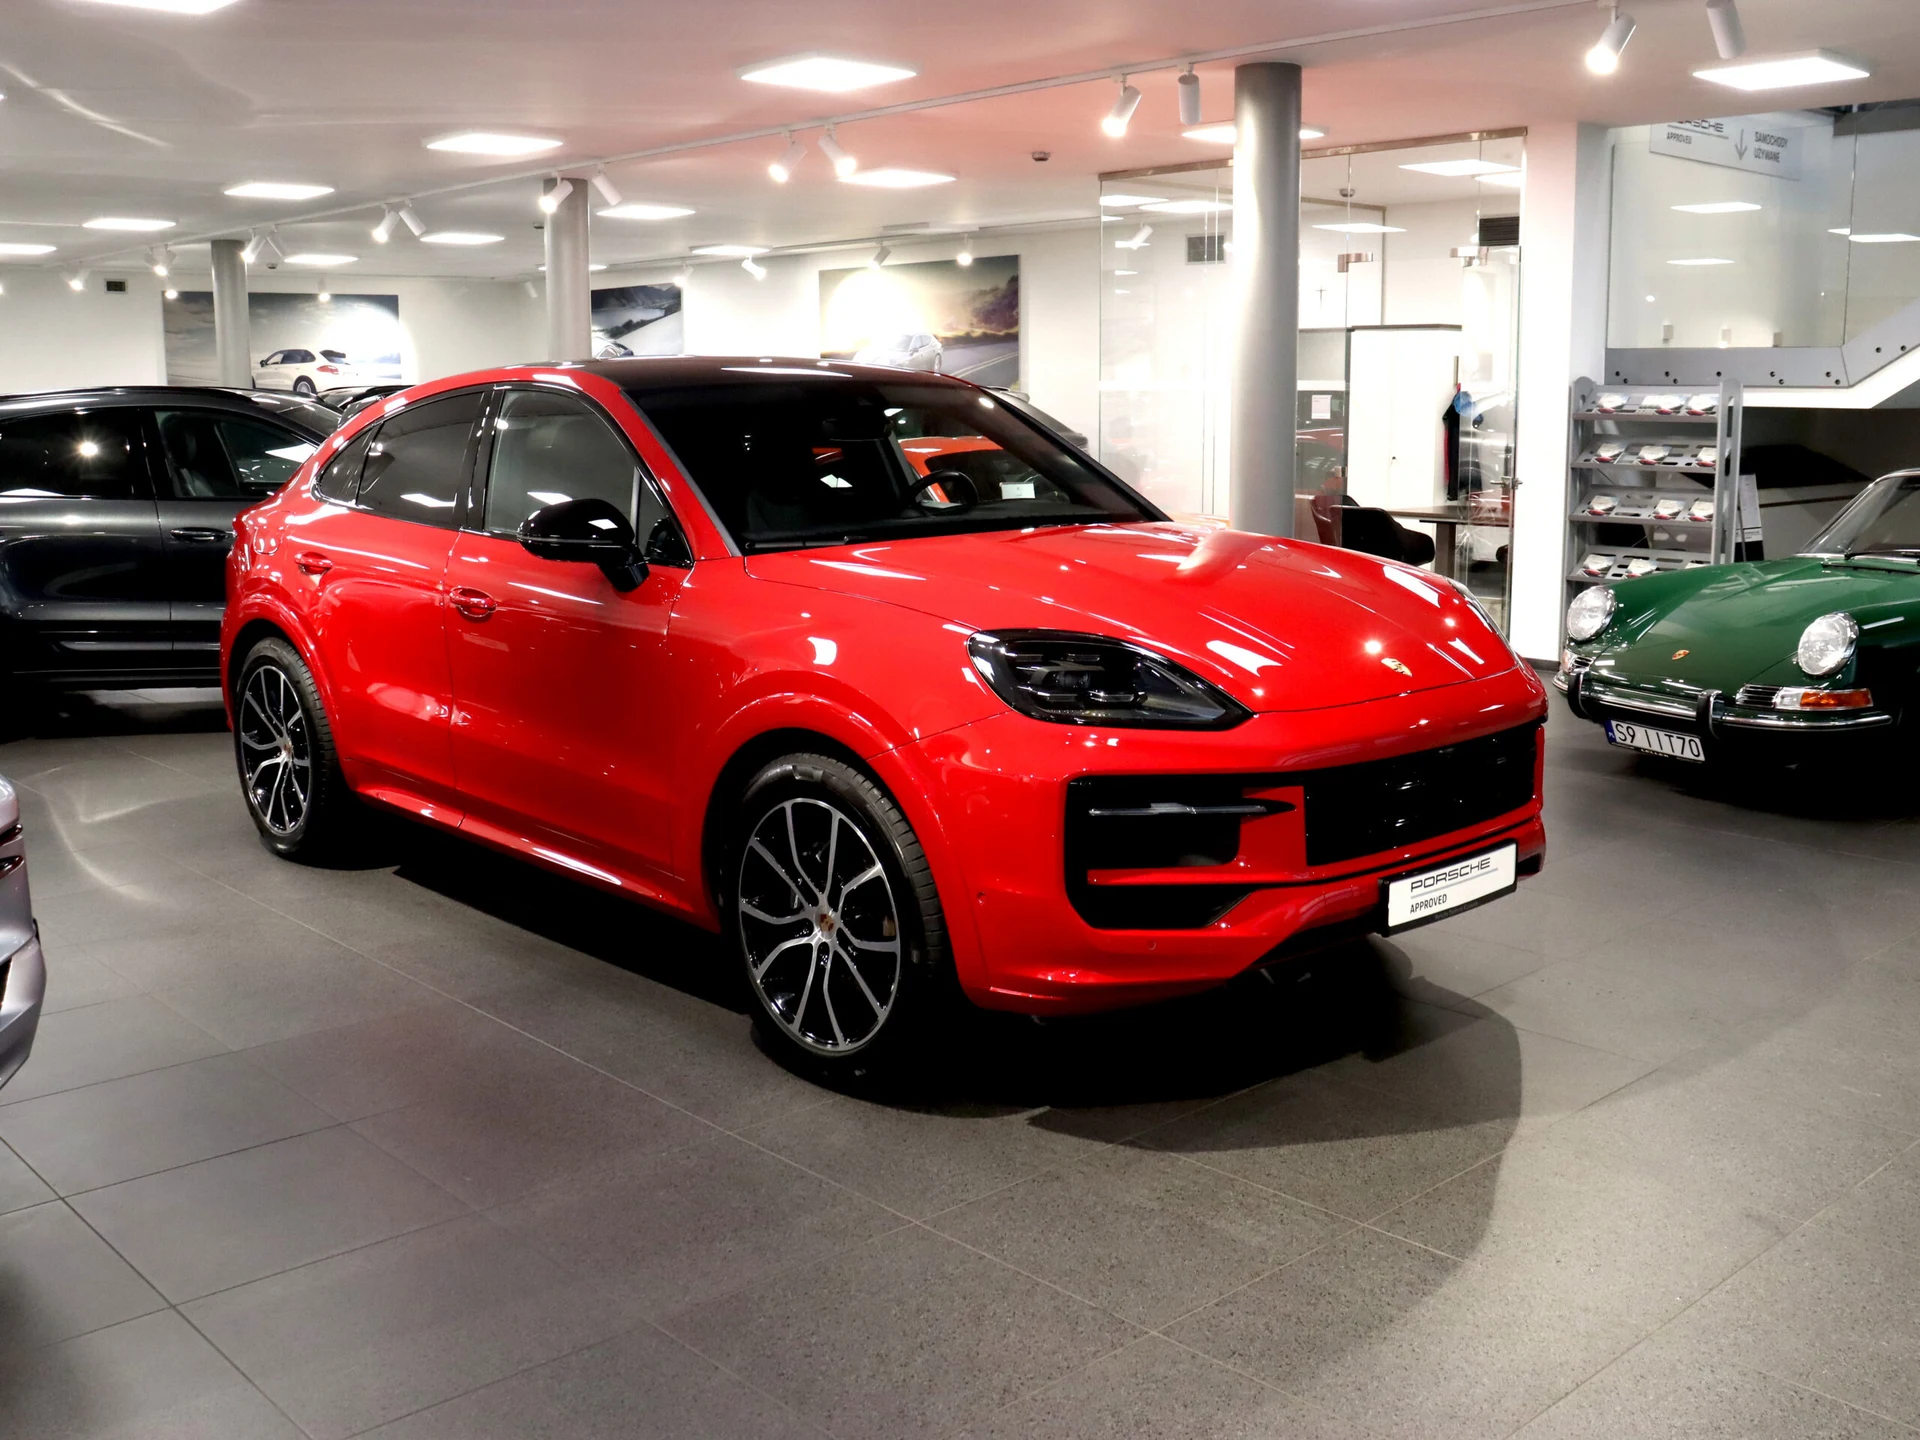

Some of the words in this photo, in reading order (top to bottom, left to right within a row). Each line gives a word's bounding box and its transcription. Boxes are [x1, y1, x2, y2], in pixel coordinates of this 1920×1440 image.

[1666, 131, 1692, 145] APPROVED
[1615, 723, 1636, 744] S9
[1410, 857, 1491, 893] PORSCHE
[1409, 893, 1448, 915] APPROVED
